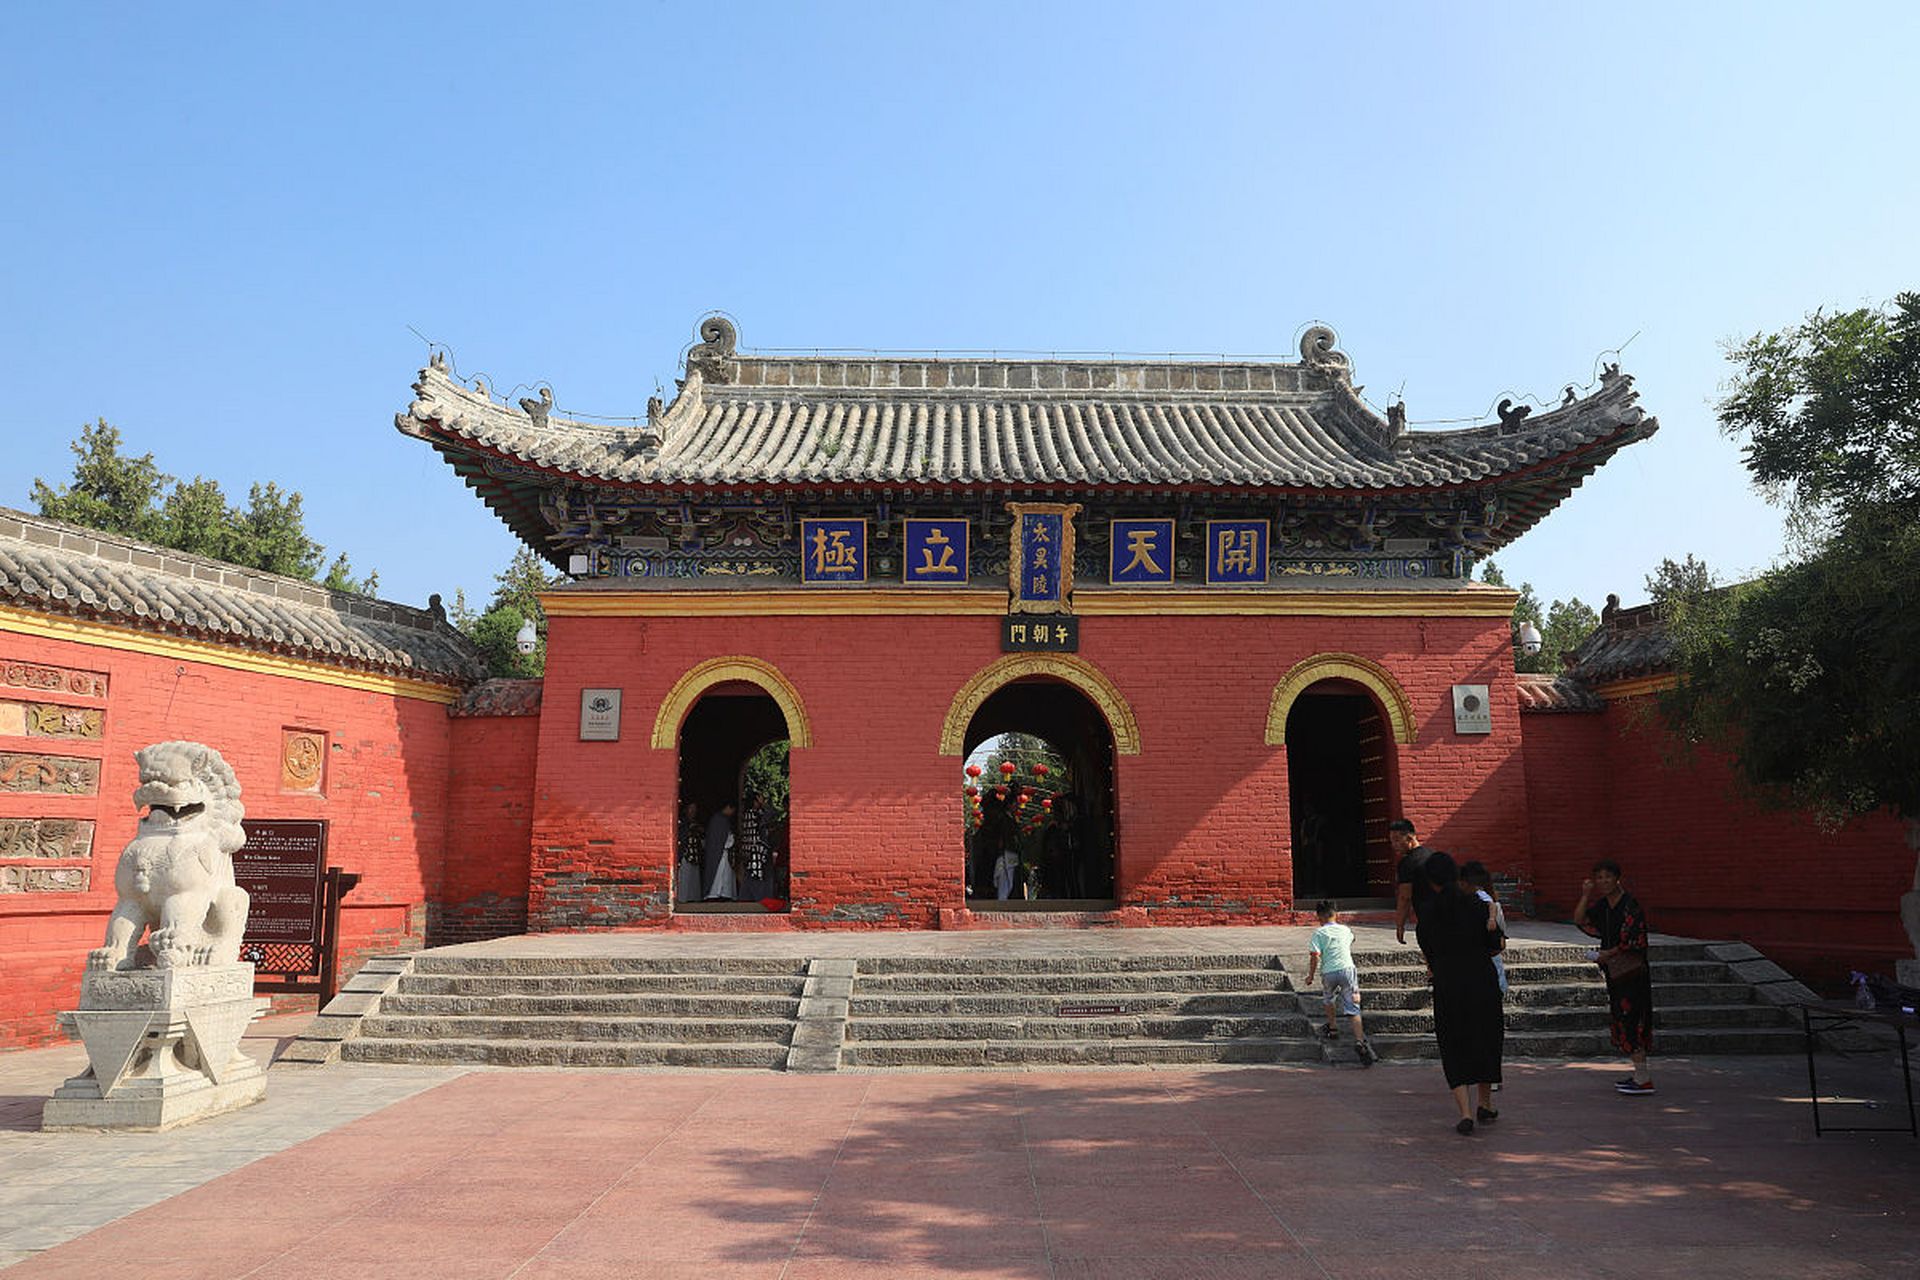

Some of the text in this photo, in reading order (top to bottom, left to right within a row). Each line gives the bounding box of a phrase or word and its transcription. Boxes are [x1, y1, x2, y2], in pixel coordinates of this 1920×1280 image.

[811, 527, 858, 574] 極
[914, 528, 959, 574] 立
[1119, 530, 1165, 575] 天
[1216, 529, 1258, 576] 開
